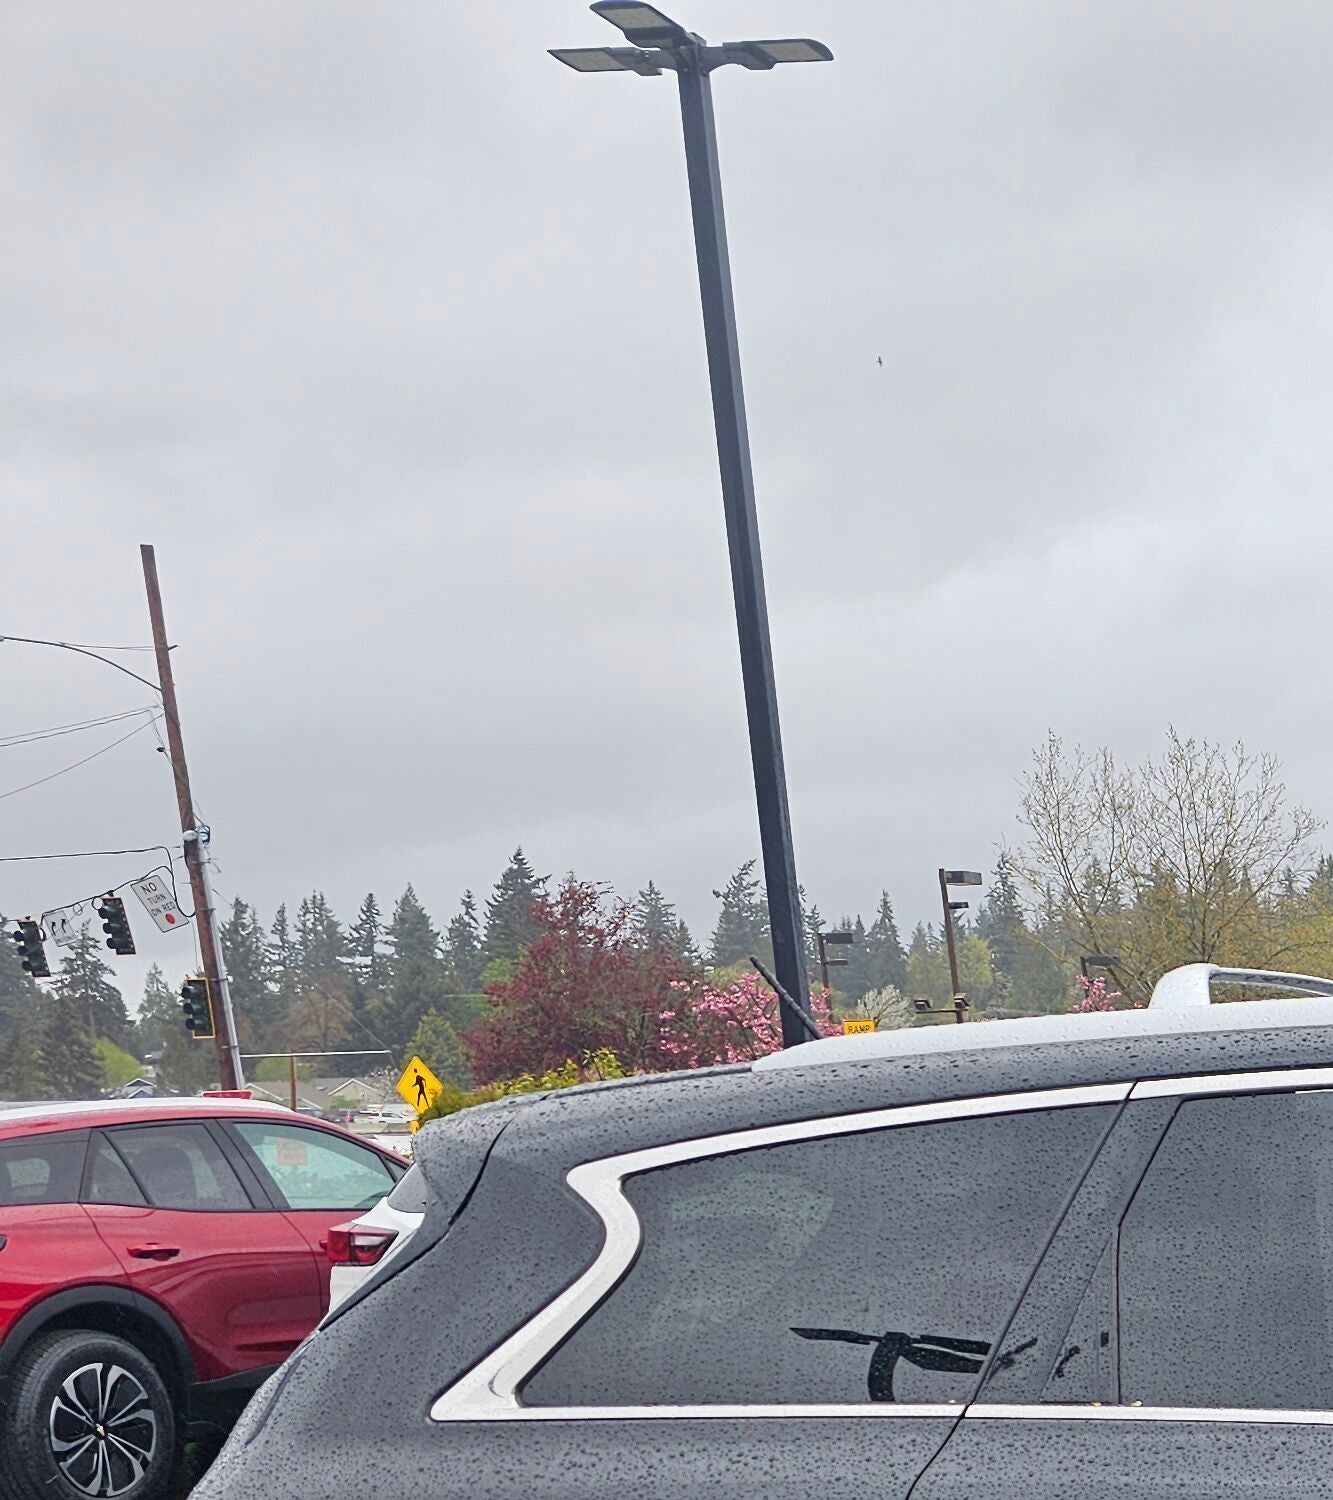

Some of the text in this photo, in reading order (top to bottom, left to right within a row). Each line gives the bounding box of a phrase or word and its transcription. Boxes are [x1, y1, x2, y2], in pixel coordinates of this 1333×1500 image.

[140, 882, 157, 895] NO
[147, 894, 166, 904] TURN
[150, 901, 176, 917] ON RED
[847, 1024, 870, 1034] RAMP
